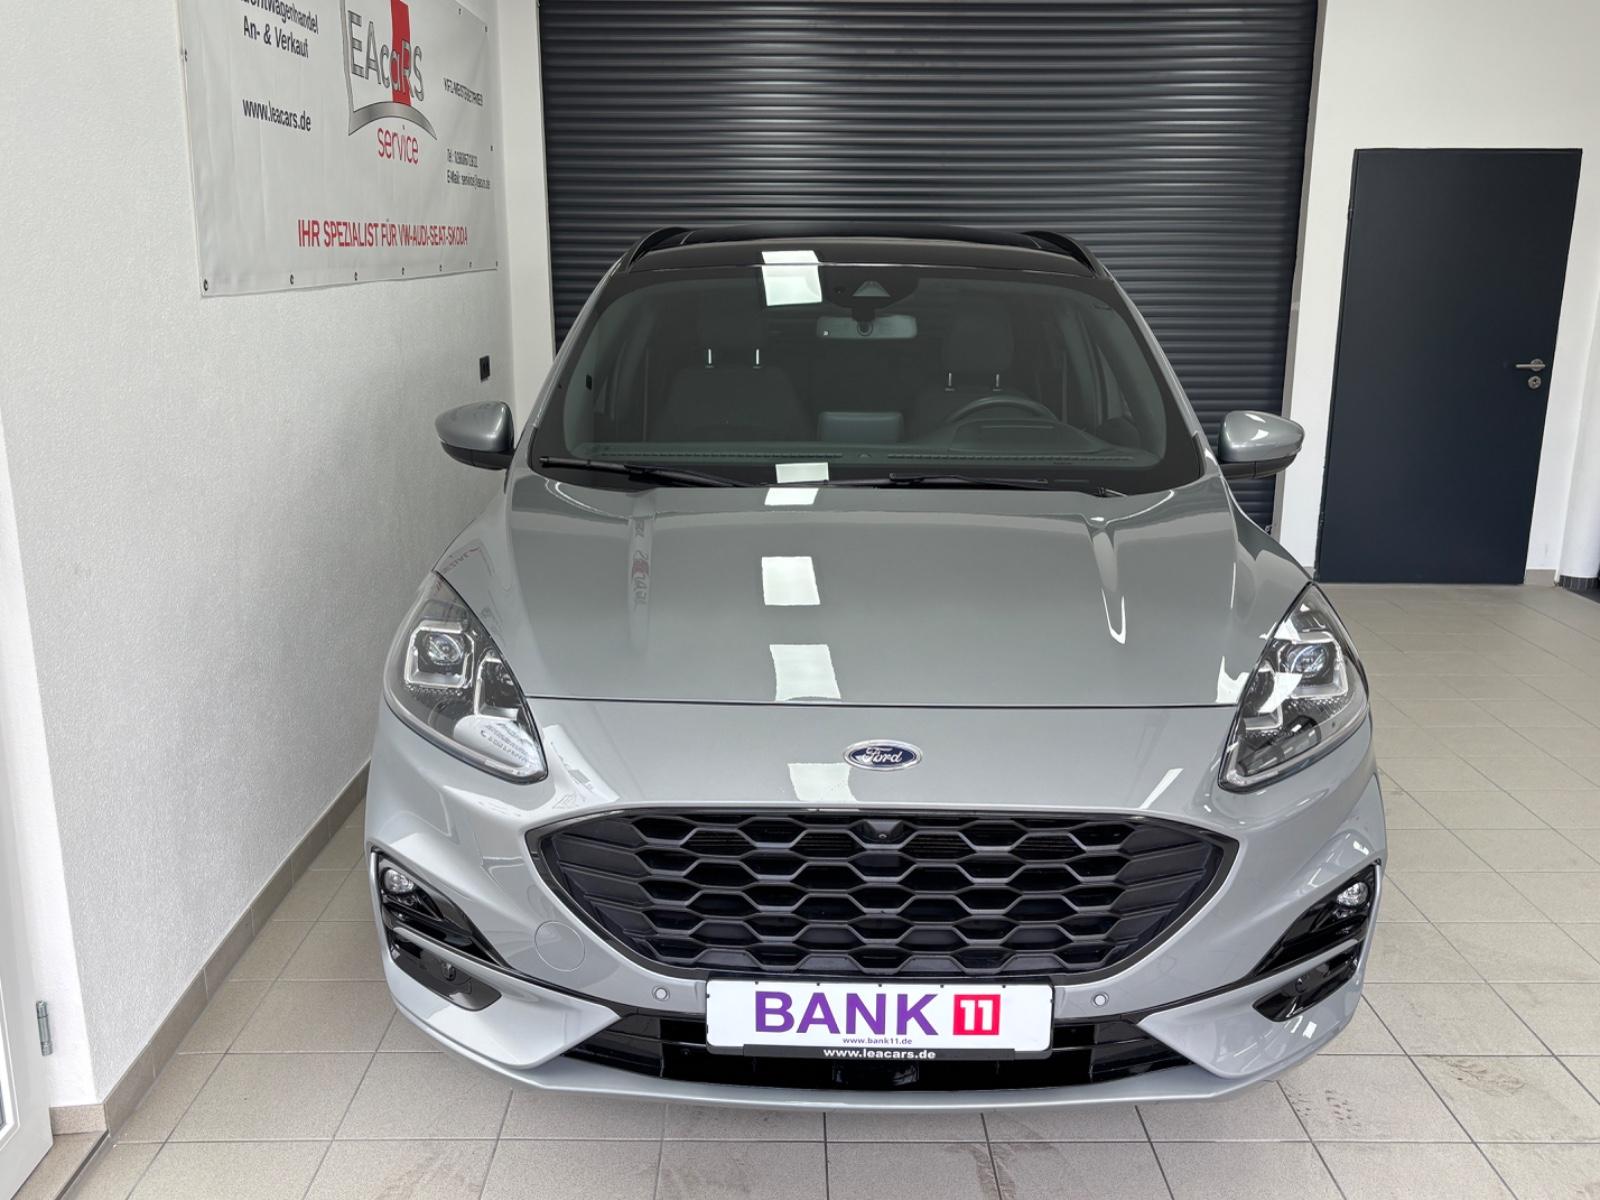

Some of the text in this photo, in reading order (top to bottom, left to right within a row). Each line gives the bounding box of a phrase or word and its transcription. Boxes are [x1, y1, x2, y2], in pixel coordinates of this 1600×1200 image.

[243, 15, 308, 58] An- & Verkauf
[242, 99, 311, 132] www.leacars.de
[377, 124, 419, 165] service
[298, 219, 320, 247] IHR
[323, 221, 379, 247] SPEZIALIST
[381, 218, 398, 247] FÜR
[855, 746, 903, 763] Ford
[754, 990, 994, 1036] BANK 11
[822, 1048, 937, 1059] www.leacars.de
[842, 1037, 913, 1045] www.bank11.de
